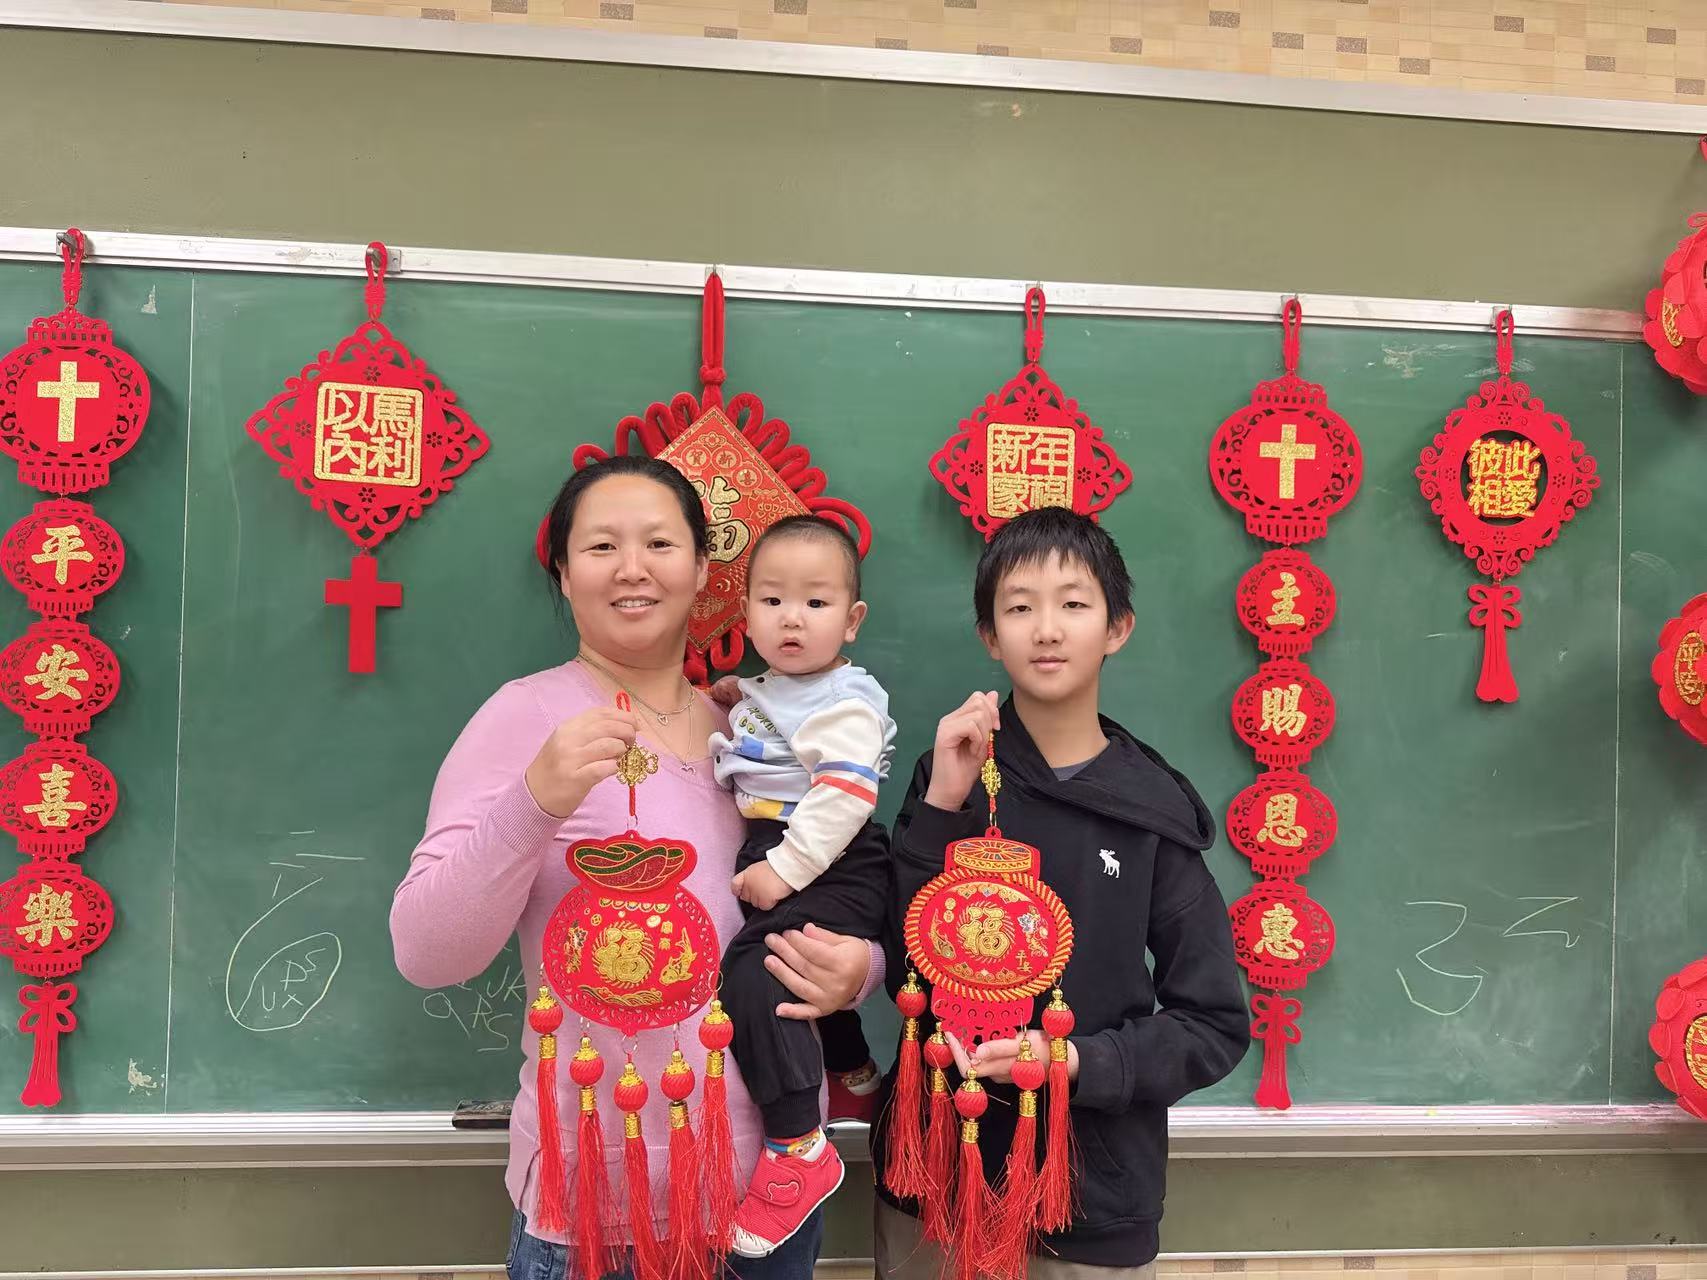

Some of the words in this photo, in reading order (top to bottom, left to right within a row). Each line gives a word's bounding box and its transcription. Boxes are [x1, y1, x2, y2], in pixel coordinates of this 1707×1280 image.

[323, 389, 415, 438] 以馬
[993, 431, 1069, 474] 新年
[1469, 439, 1540, 478] 彼此
[993, 473, 1068, 511] 蒙福
[1469, 478, 1536, 517] 相愛
[16, 525, 93, 946] 平安喜樂
[1254, 571, 1308, 960] 主賜恩惠
[595, 927, 651, 983] 福
[960, 906, 1011, 957] 福
